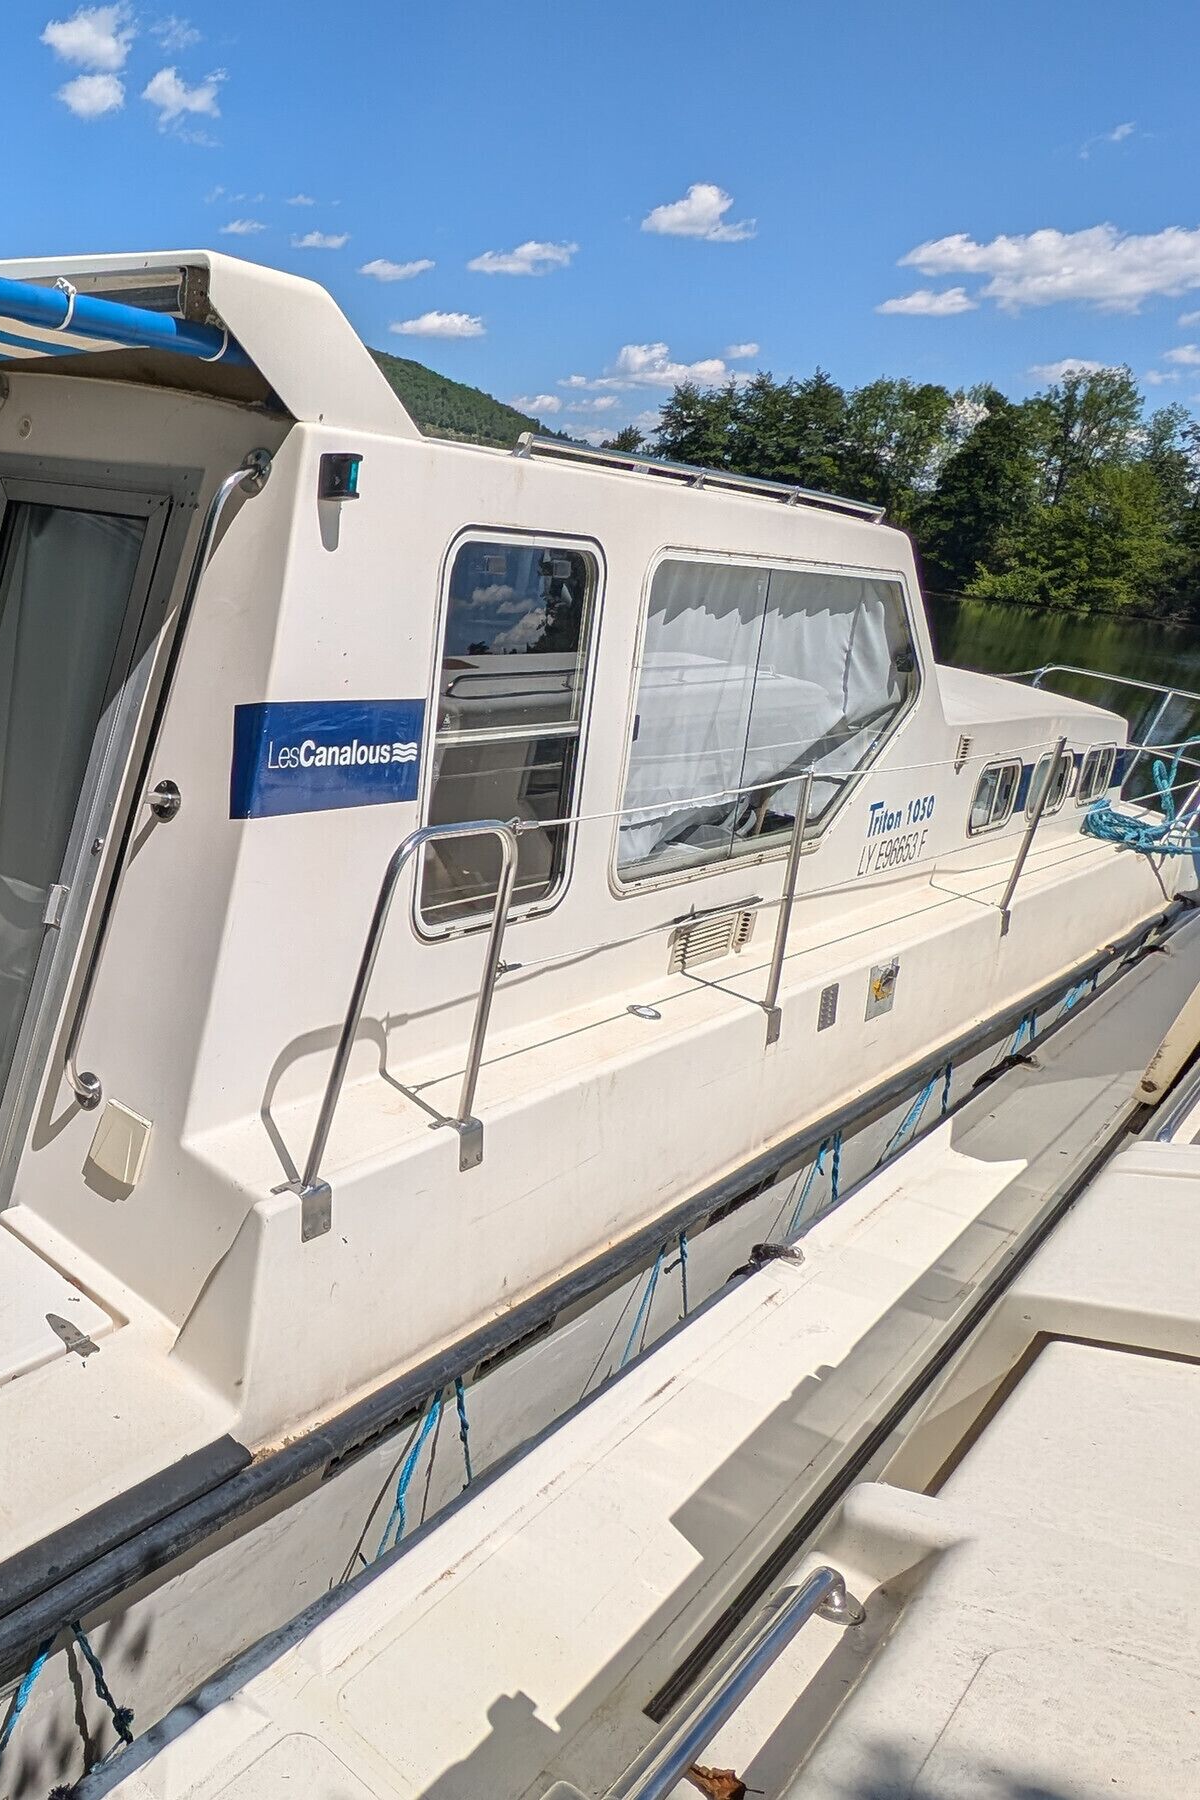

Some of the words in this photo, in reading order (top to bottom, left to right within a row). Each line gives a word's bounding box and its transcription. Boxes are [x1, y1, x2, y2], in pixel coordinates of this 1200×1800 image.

[867, 801, 902, 838] Triton
[906, 795, 935, 825] 1050
[857, 843, 877, 876] LY
[917, 829, 928, 857] F
